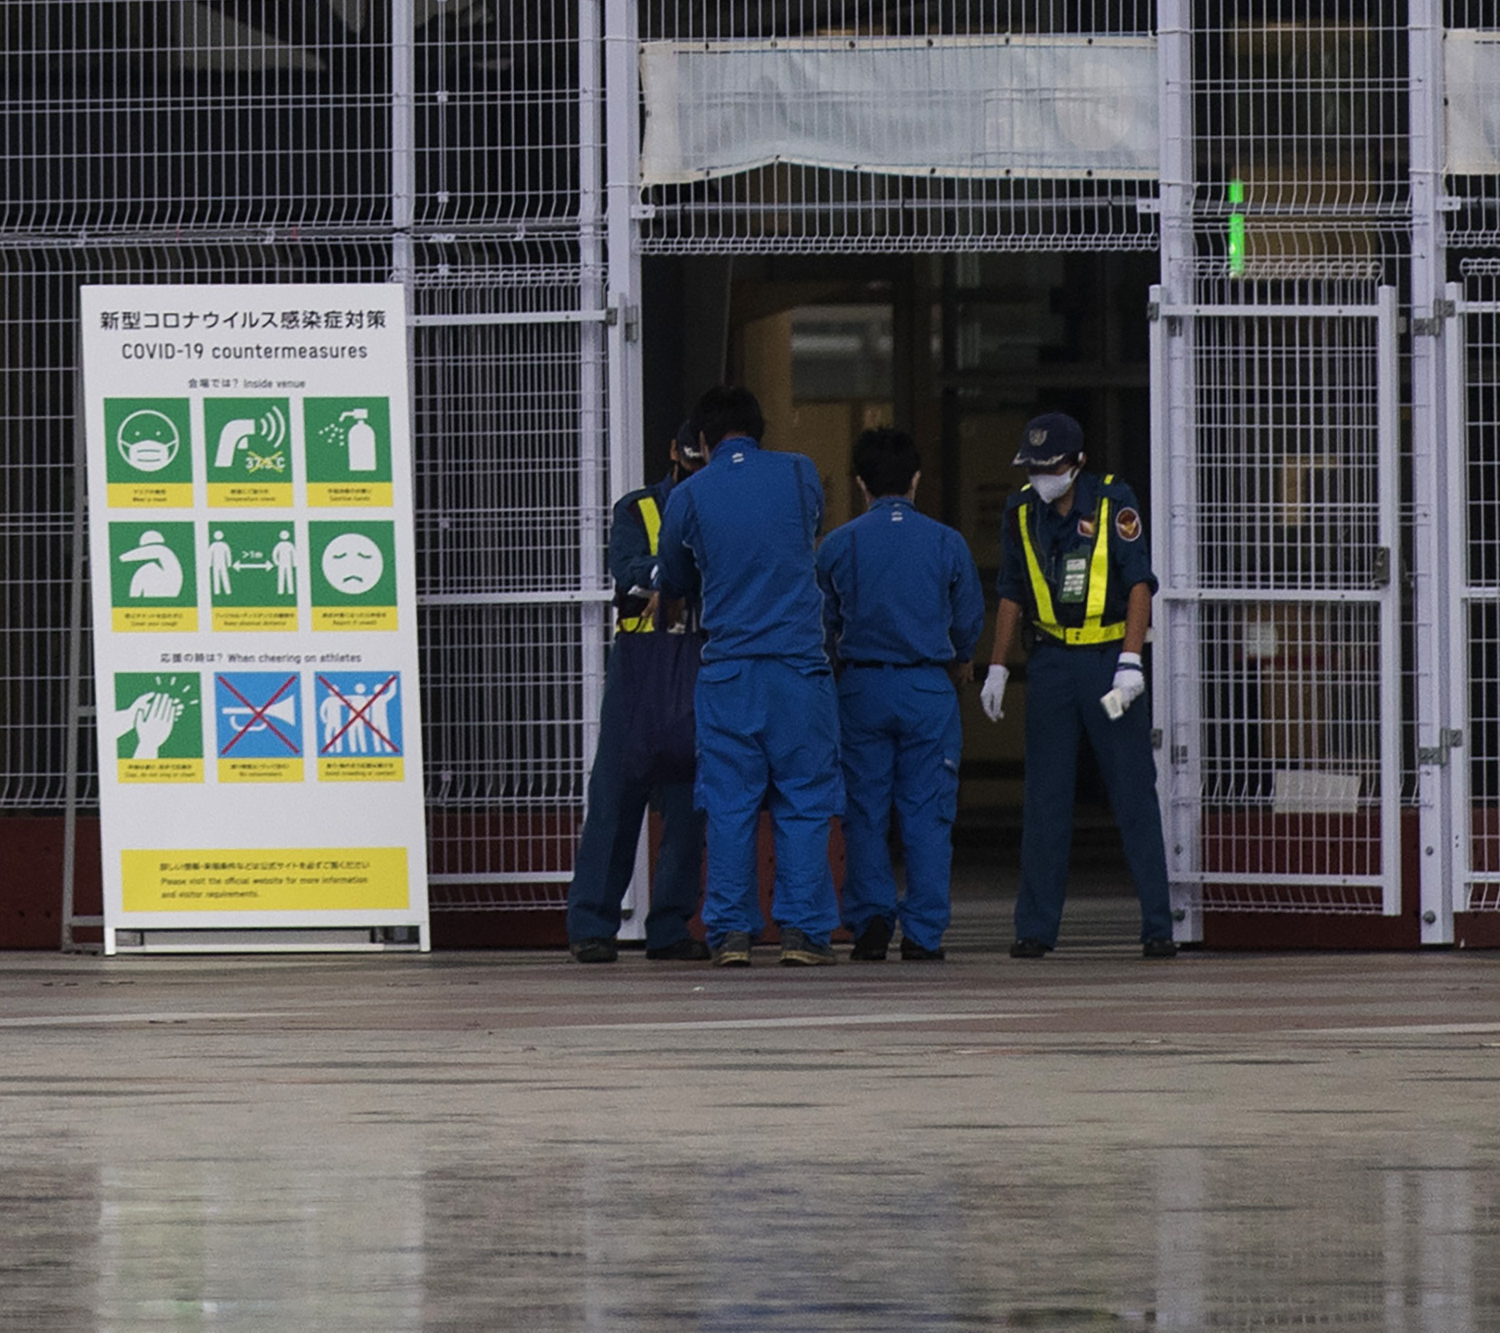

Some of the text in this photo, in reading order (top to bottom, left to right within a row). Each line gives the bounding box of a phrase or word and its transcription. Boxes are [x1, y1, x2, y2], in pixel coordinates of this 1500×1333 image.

[100, 310, 387, 330] 新型コロナウイルス感染症対策
[121, 342, 368, 360] COVID-19 countermeasures
[244, 378, 273, 389] Inside
[276, 380, 306, 389] venue
[228, 653, 256, 663] When
[258, 653, 301, 665] cheering
[304, 654, 317, 663] on
[320, 652, 362, 663] athletes
